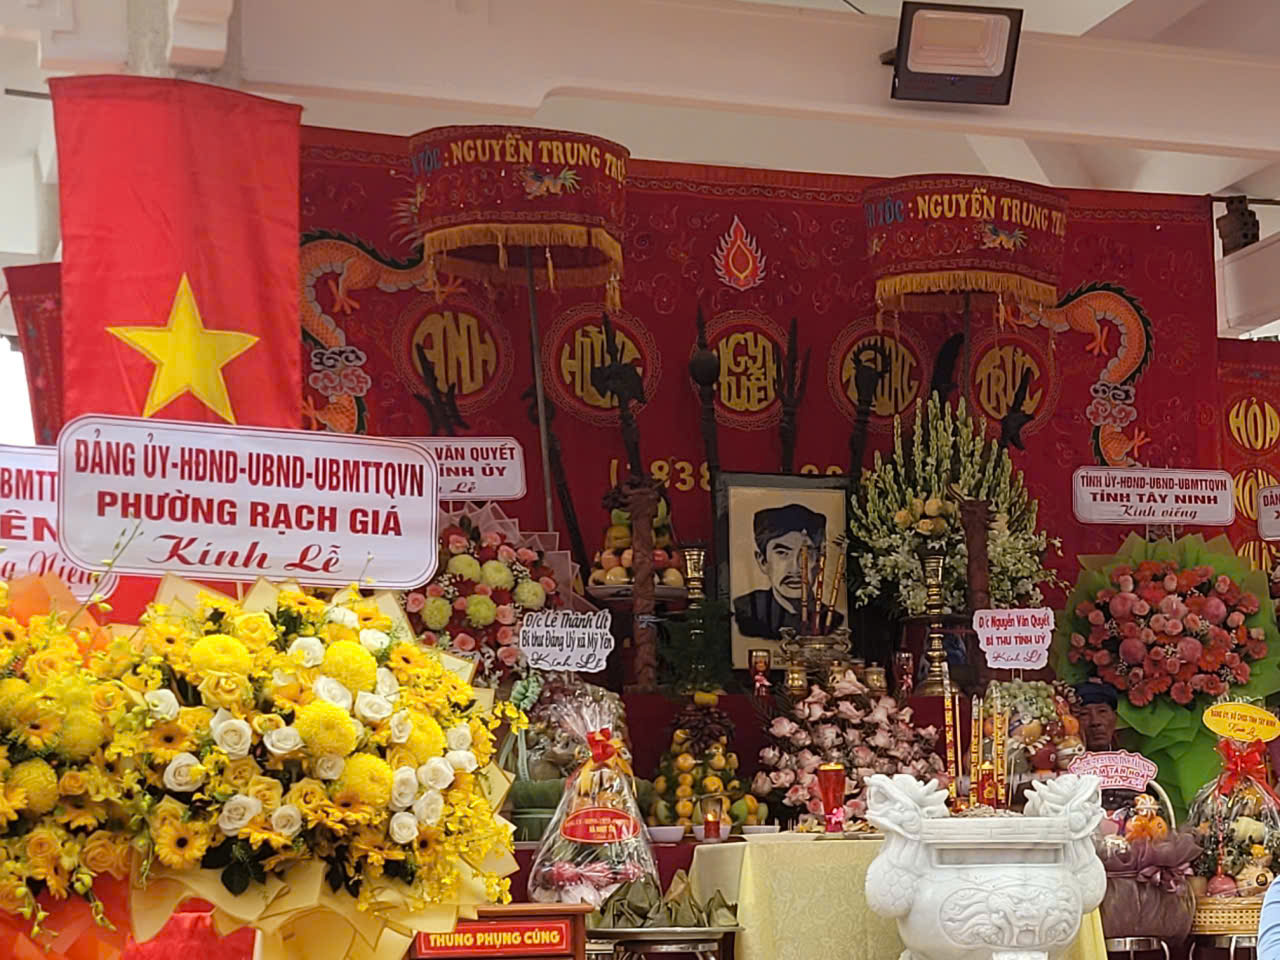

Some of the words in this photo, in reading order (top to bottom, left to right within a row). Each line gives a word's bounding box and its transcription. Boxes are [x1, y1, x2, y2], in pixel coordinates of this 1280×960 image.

[450, 133, 533, 165] NGUYỄN
[538, 140, 600, 168] TRUNG
[917, 187, 996, 220] NGUYỄN
[1000, 198, 1048, 231] TRUNG
[411, 311, 497, 394] ANH
[1228, 397, 1280, 450] HỎA
[75, 428, 136, 477] ĐẢNG
[435, 444, 465, 461] VĂN
[470, 443, 516, 462] QUYẾT
[439, 463, 475, 477] ỈNH
[481, 463, 507, 477] ỦY
[1081, 472, 1102, 488] TỈNH
[1089, 490, 1130, 503] TỈNH
[1136, 492, 1168, 504] TÂY
[1175, 494, 1218, 504] NINH
[0, 509, 57, 542] ÊN
[97, 489, 244, 526] PHƯỜNG
[250, 501, 338, 536] RẠCH
[350, 505, 402, 536] GIÁ
[147, 534, 273, 569] Kính
[283, 544, 342, 573] Lễ
[476, 931, 521, 948] PHỤNG
[524, 928, 560, 944] CÚNG
